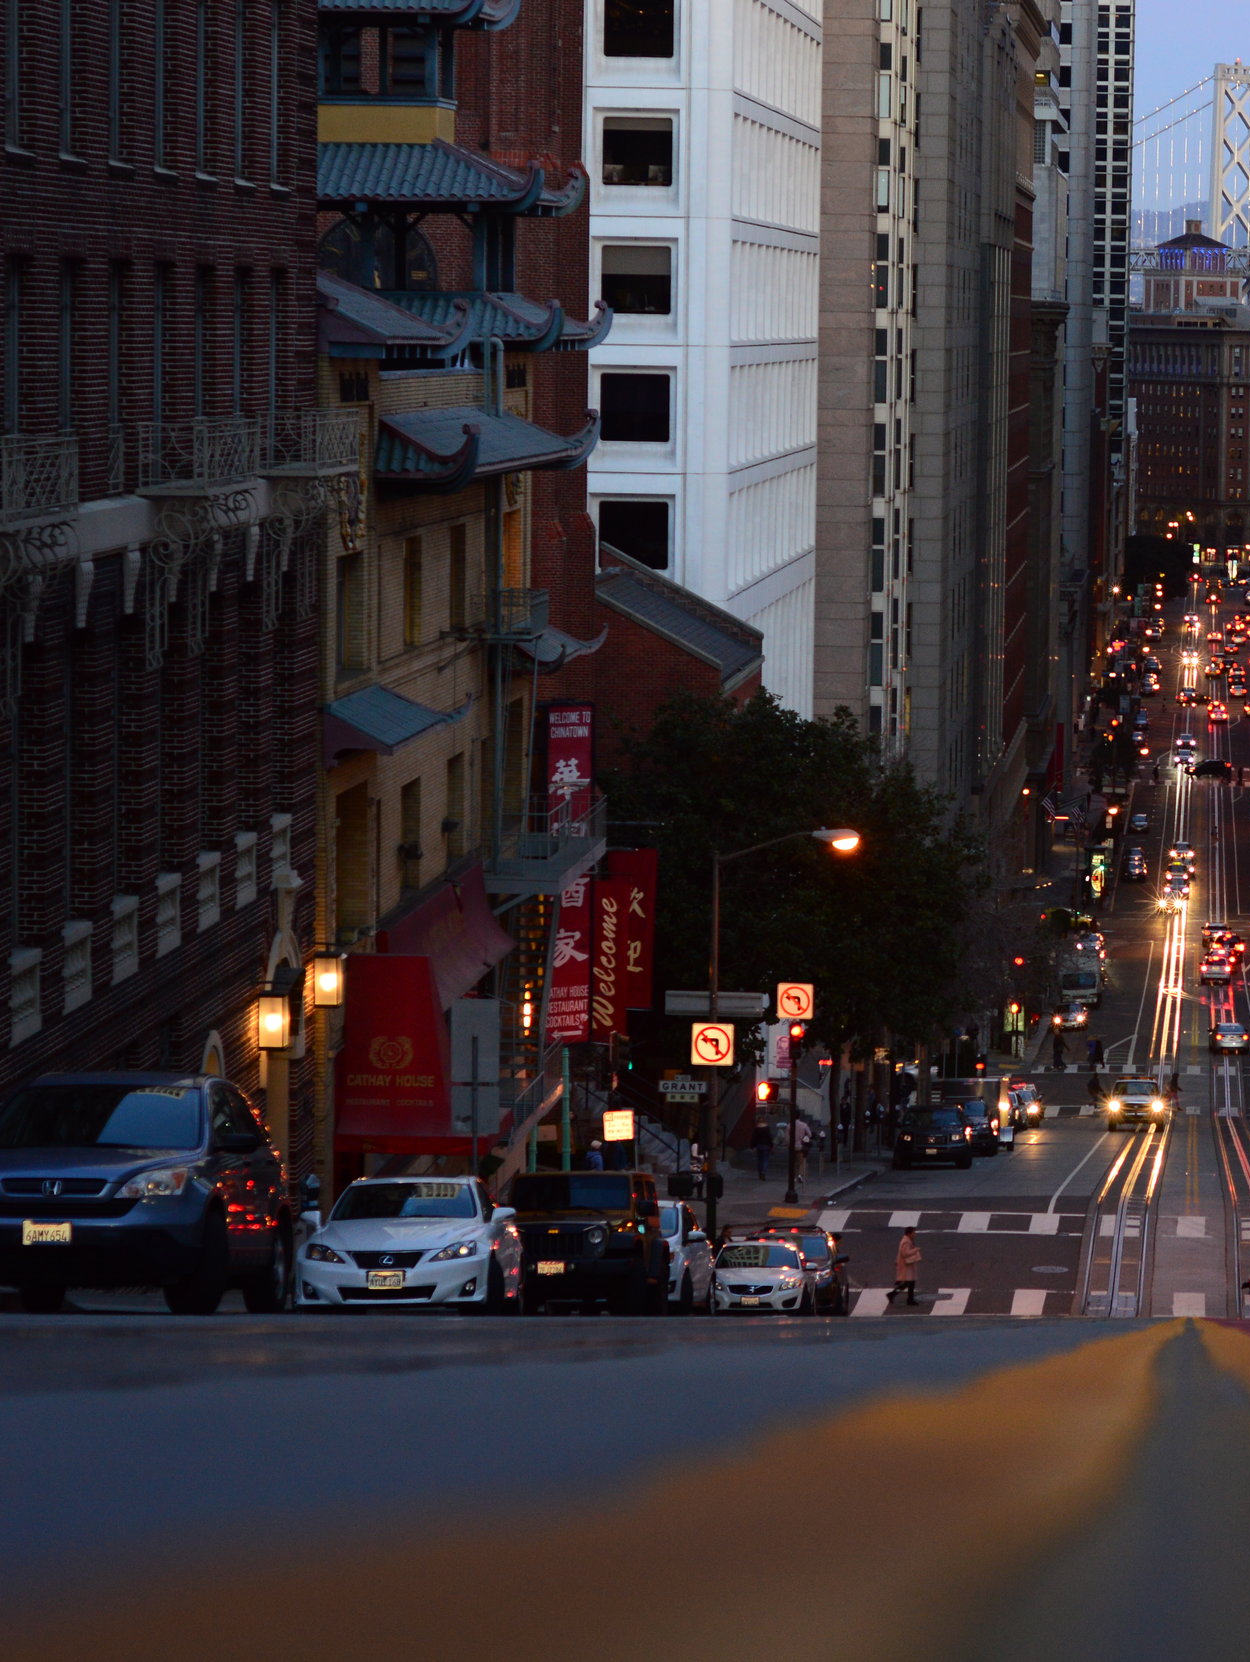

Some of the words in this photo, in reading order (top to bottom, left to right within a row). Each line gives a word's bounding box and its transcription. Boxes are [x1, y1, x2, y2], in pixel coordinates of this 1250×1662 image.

[549, 712, 580, 724] WELCOME
[582, 711, 591, 723] TO
[550, 726, 589, 738] CHINATOWN
[592, 896, 618, 1030] Welcome
[550, 986, 568, 998] ATHAY
[569, 985, 589, 997] HOUSE
[346, 1074, 392, 1087] CATHAY
[395, 1074, 435, 1088] HOUSE
[662, 1082, 703, 1091] GRANT
